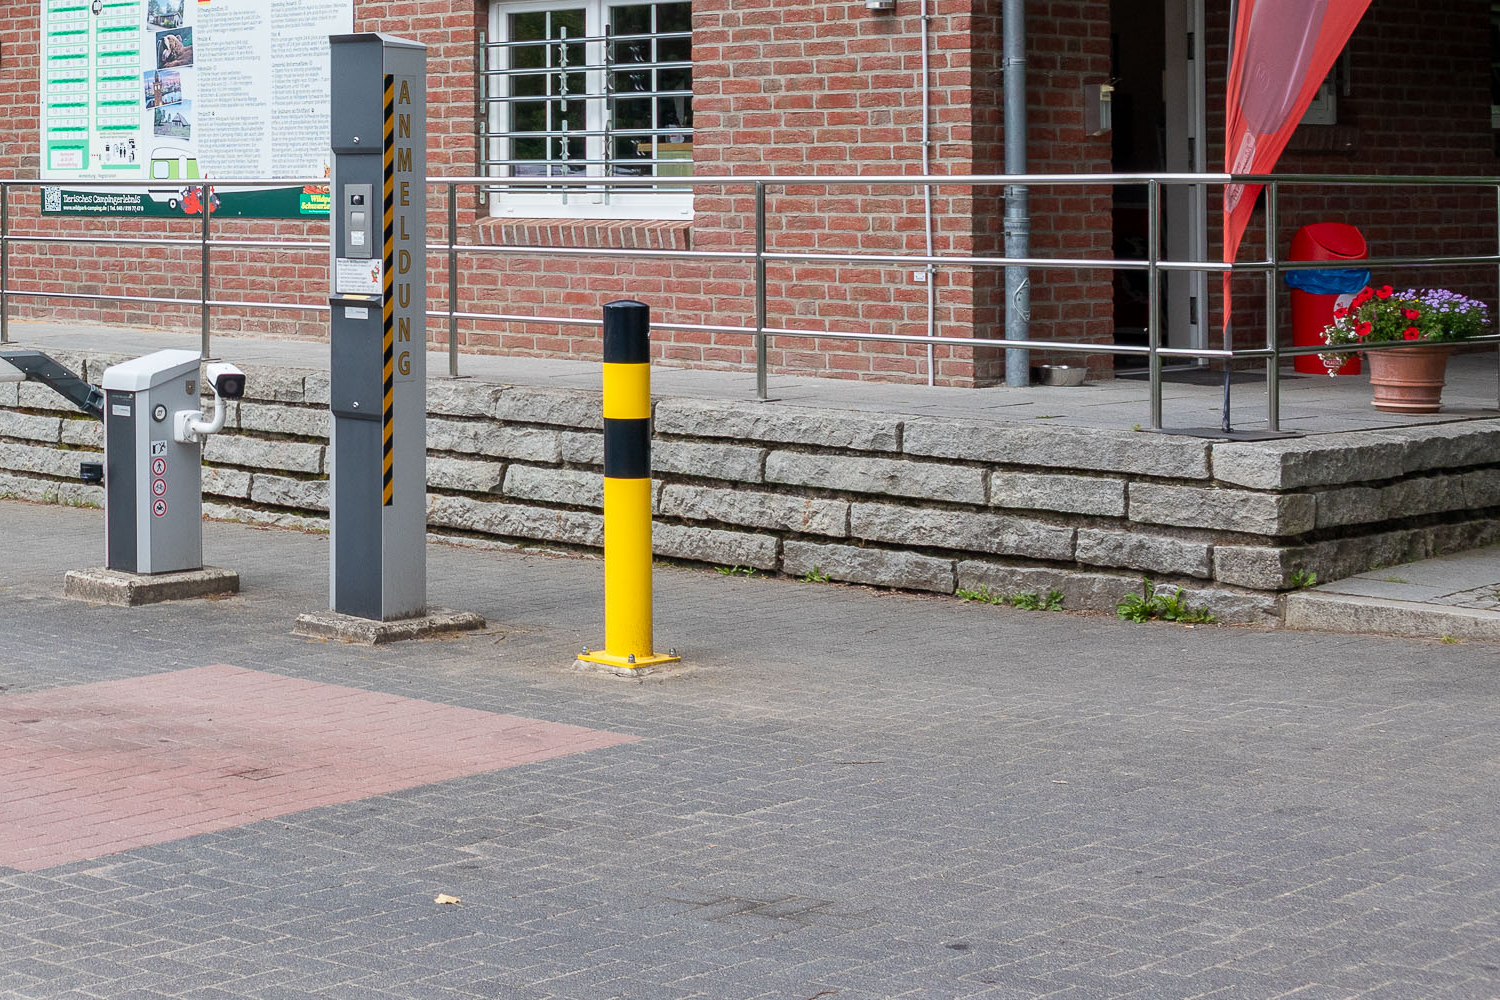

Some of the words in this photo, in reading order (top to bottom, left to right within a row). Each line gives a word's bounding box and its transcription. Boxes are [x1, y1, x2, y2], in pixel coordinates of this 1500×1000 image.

[62, 195, 92, 203] Tierisches
[93, 195, 141, 205] Campingerlebnis
[397, 79, 412, 376] ANMELDUNG
